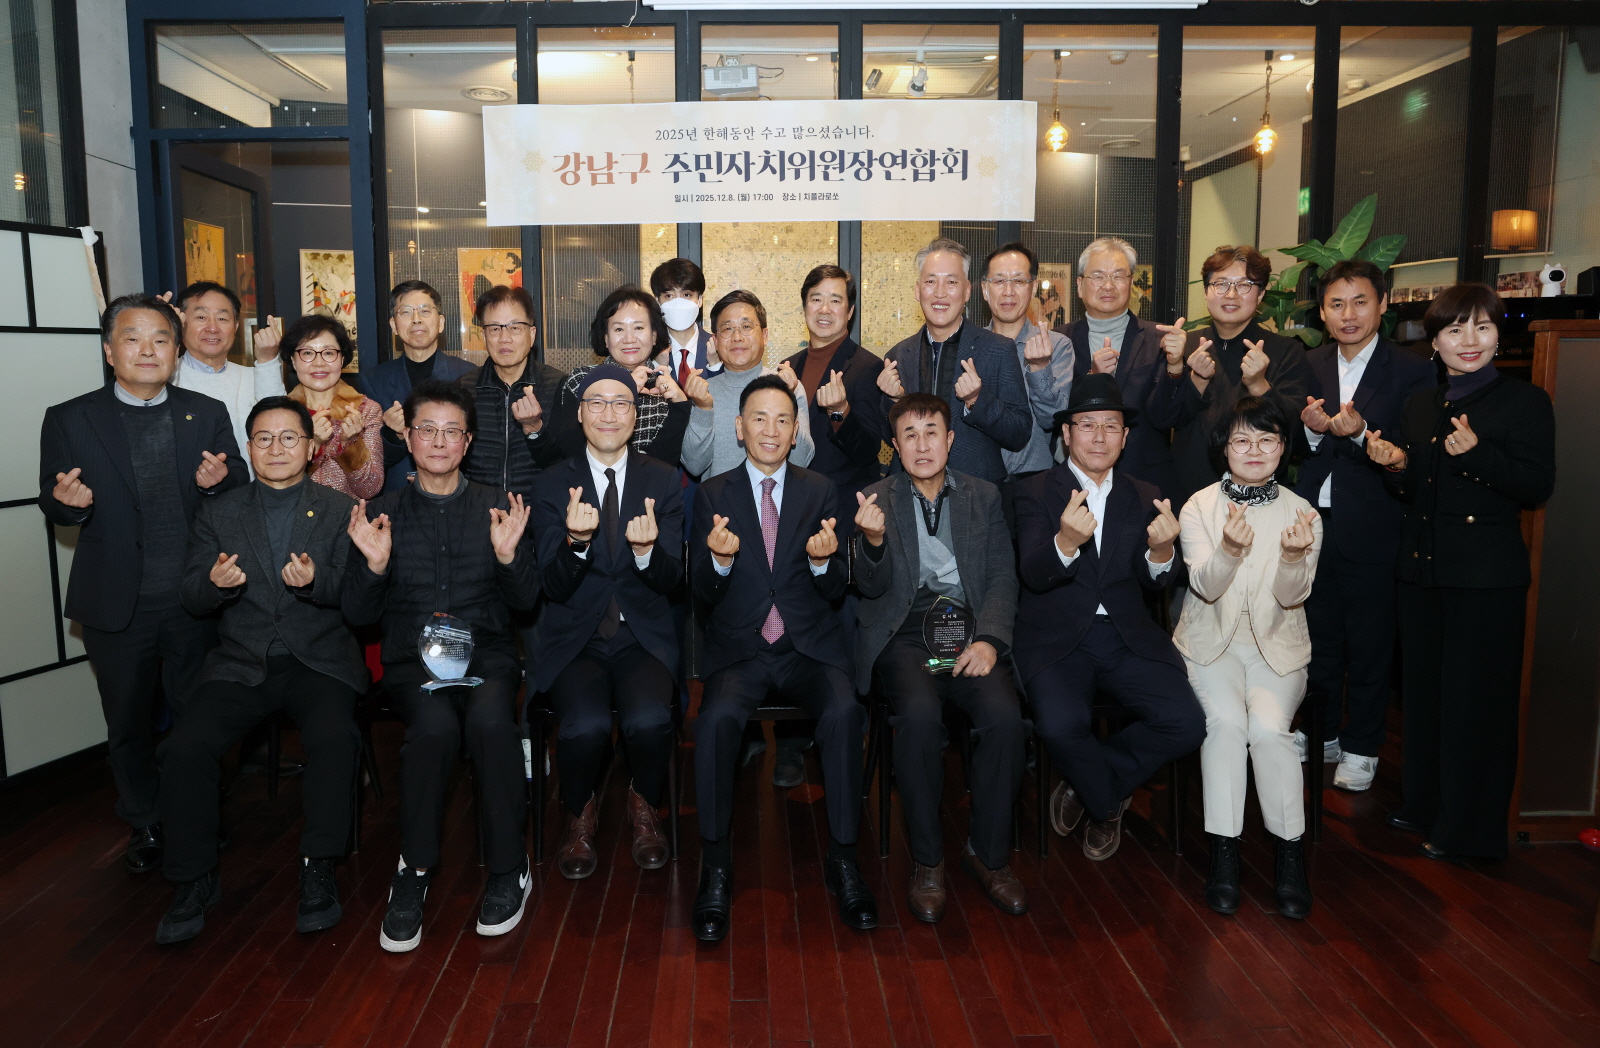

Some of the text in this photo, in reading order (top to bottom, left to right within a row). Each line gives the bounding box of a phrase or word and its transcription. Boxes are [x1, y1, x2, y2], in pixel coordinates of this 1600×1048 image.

[655, 125, 875, 142] 2025년 한해동안 수고 많으셨습니다.
[553, 147, 969, 186] 강남구 주민자치위원장연합회
[674, 194, 689, 203] 일시
[737, 193, 750, 202] (월)
[753, 193, 774, 202] 17:00
[782, 192, 796, 202] 장소
